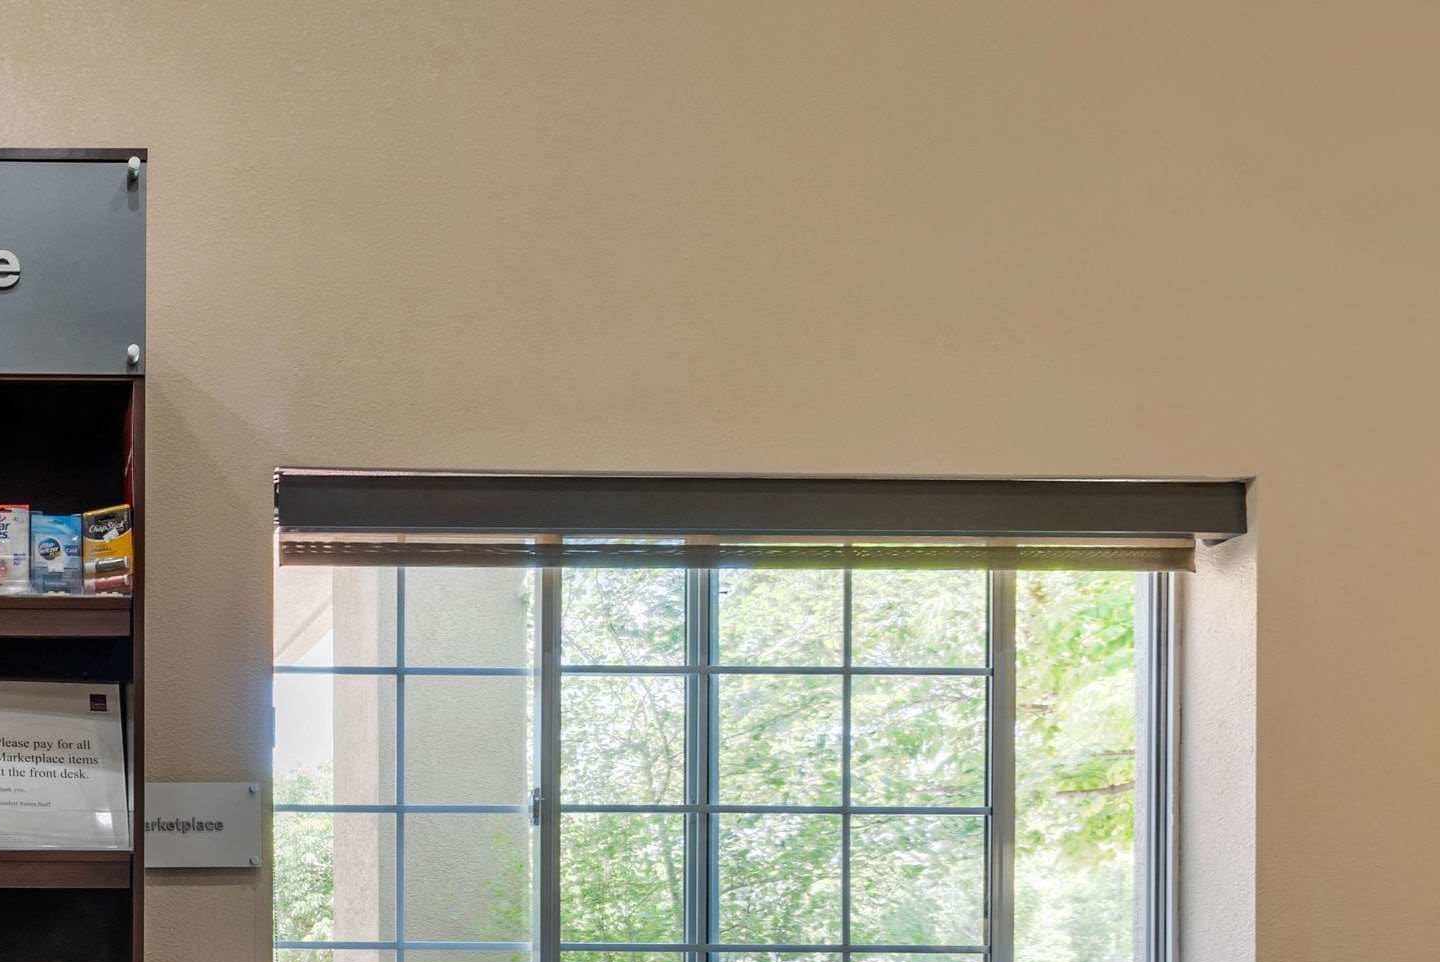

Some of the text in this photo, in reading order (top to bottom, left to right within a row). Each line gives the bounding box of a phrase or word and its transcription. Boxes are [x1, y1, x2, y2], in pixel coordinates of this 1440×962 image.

[33, 740, 53, 751] pay
[57, 739, 73, 750] for
[76, 740, 91, 750] all
[68, 753, 99, 765] items
[8, 767, 26, 778] the
[29, 767, 57, 779] front
[144, 817, 224, 834] arketplace
